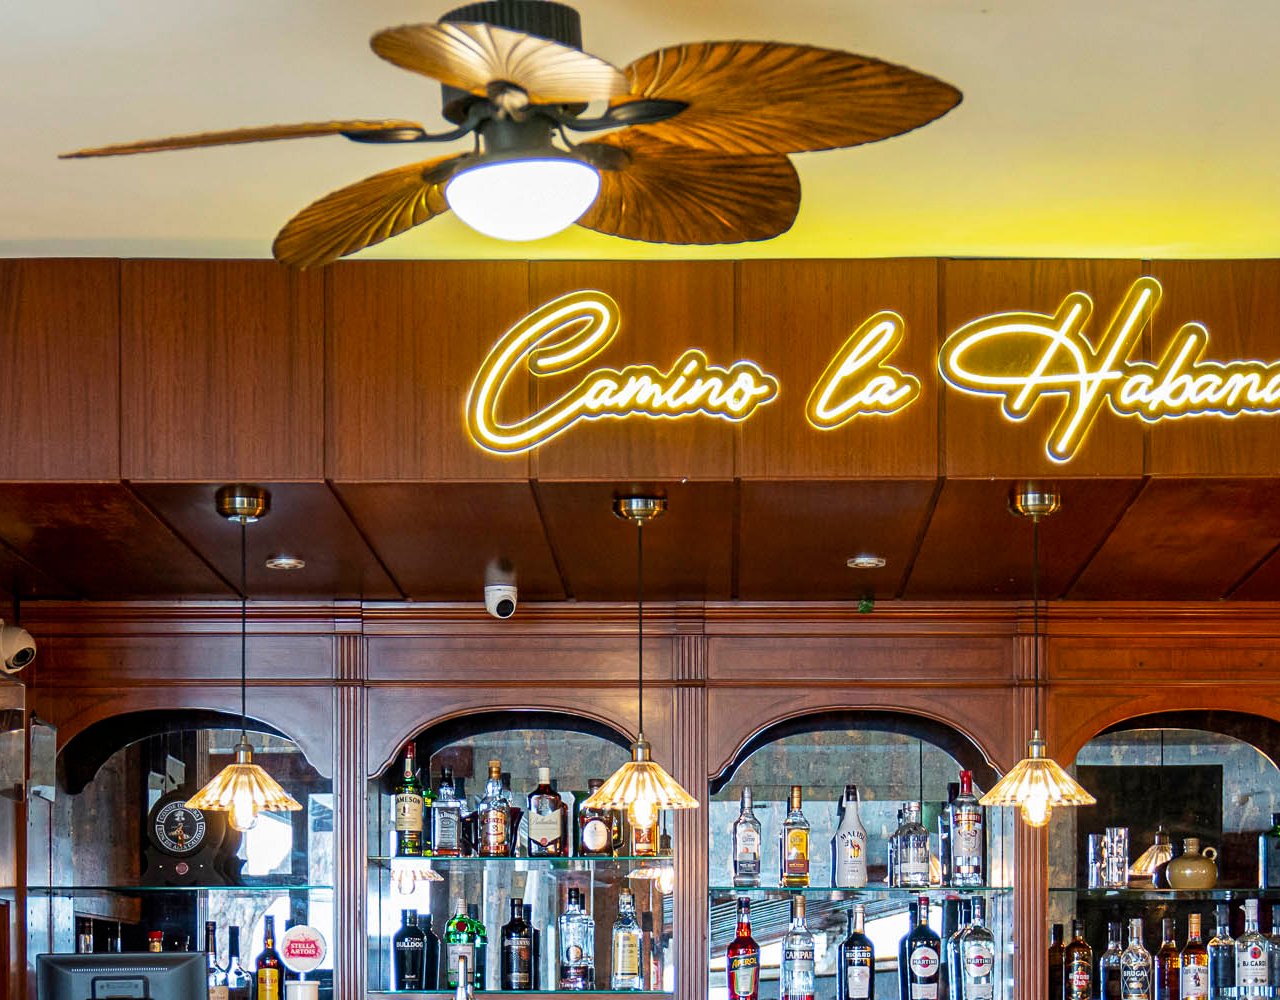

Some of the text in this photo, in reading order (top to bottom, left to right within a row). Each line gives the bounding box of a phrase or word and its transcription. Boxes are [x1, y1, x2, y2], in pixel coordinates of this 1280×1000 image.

[470, 295, 773, 447] Camino
[812, 315, 914, 424] la
[785, 951, 813, 960] CAMPAR
[731, 957, 757, 969] APEROL
